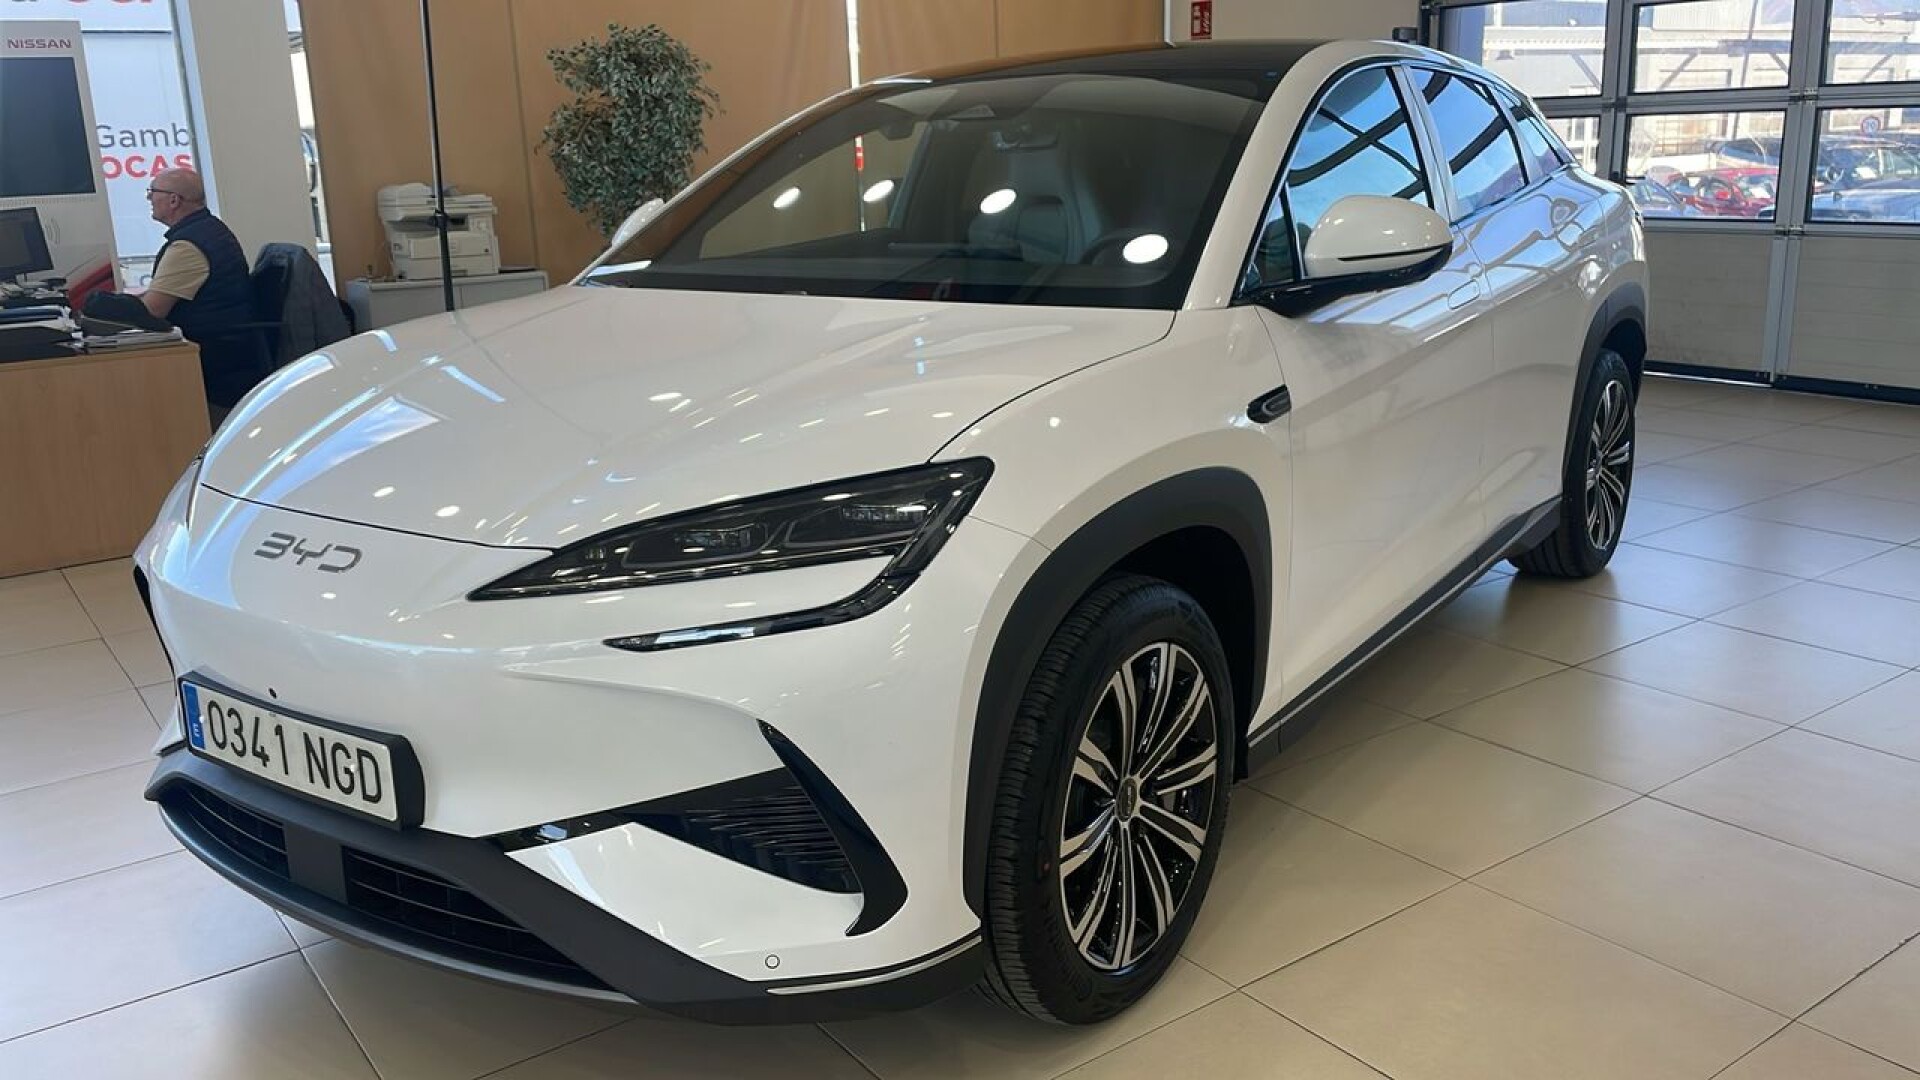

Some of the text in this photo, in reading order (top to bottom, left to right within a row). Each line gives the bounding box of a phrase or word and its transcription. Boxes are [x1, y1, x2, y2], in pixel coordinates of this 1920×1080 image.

[7, 39, 72, 49] NISSAN
[255, 532, 362, 573] BYD
[192, 724, 200, 738] E
[207, 700, 382, 804] 0341 NGD
